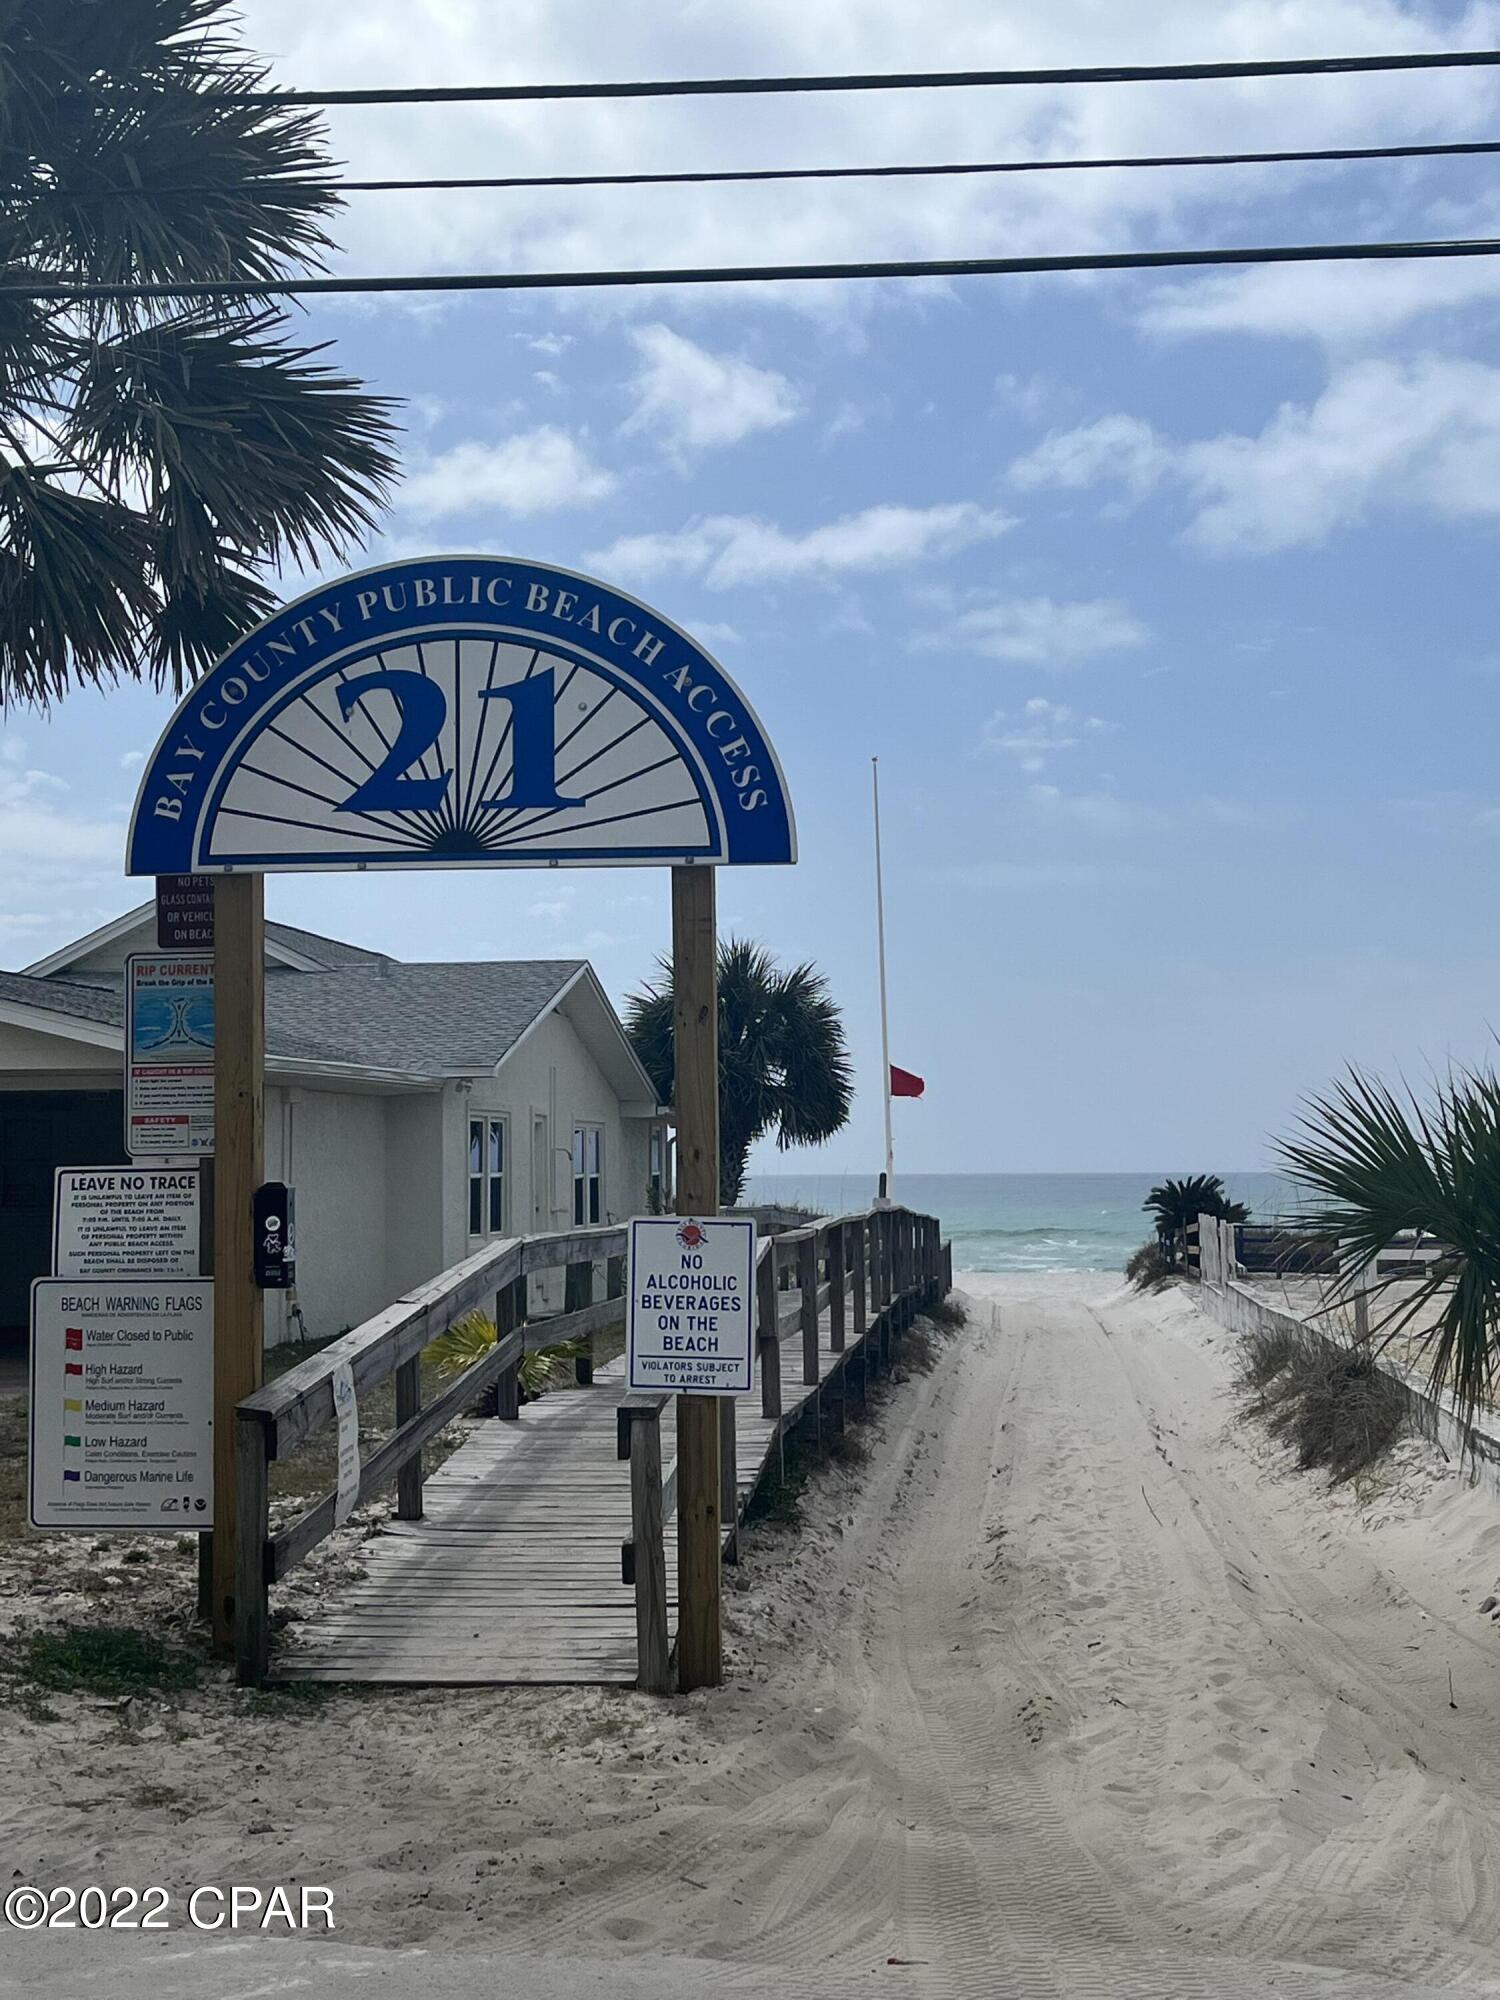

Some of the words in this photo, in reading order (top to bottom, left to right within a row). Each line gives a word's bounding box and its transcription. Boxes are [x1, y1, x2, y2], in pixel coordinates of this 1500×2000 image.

[153, 733, 206, 822] BAY
[198, 601, 345, 731] COUNTY
[355, 575, 515, 622] PUBLIC
[524, 581, 668, 667] BEACH
[662, 658, 770, 812] ACCESS
[334, 667, 586, 812] 21
[178, 876, 190, 887] NO
[161, 894, 185, 905] GLASS
[186, 894, 214, 904] CONTAI
[167, 912, 180, 922] OR
[182, 912, 214, 922] VEHICL
[174, 930, 187, 940] ON
[189, 928, 214, 940] BEAC
[136, 965, 156, 976] RIP
[160, 964, 215, 976] CURRENT
[71, 1177, 115, 1191] LEAVE
[120, 1176, 145, 1190] NO
[150, 1176, 196, 1190] TRACE
[681, 1254, 702, 1270] NO
[646, 1274, 738, 1291] ALCOHOLIC
[61, 1297, 100, 1312] BEACH
[106, 1296, 160, 1311] WARNING
[165, 1296, 203, 1310] FLAGS
[641, 1294, 742, 1312] BEVERAGES
[658, 1315, 679, 1330] ON
[686, 1316, 718, 1332] THE
[86, 1330, 114, 1342] Water
[116, 1330, 150, 1342] Closed
[152, 1330, 162, 1342] to
[164, 1330, 194, 1341] Public
[663, 1336, 719, 1352] BEACH
[86, 1364, 106, 1377] High
[110, 1364, 143, 1375] Hazard
[642, 1361, 693, 1371] VIOLATORS
[696, 1362, 740, 1373] SUBJECT
[664, 1374, 676, 1383] TO
[679, 1374, 717, 1384] ARREST
[85, 1400, 126, 1411] Medium
[128, 1400, 165, 1411] Hazard
[85, 1436, 106, 1448] Low
[110, 1436, 148, 1448] Hazard
[84, 1470, 137, 1484] Dangerous
[140, 1470, 173, 1482] Marine
[176, 1470, 194, 1482] Life
